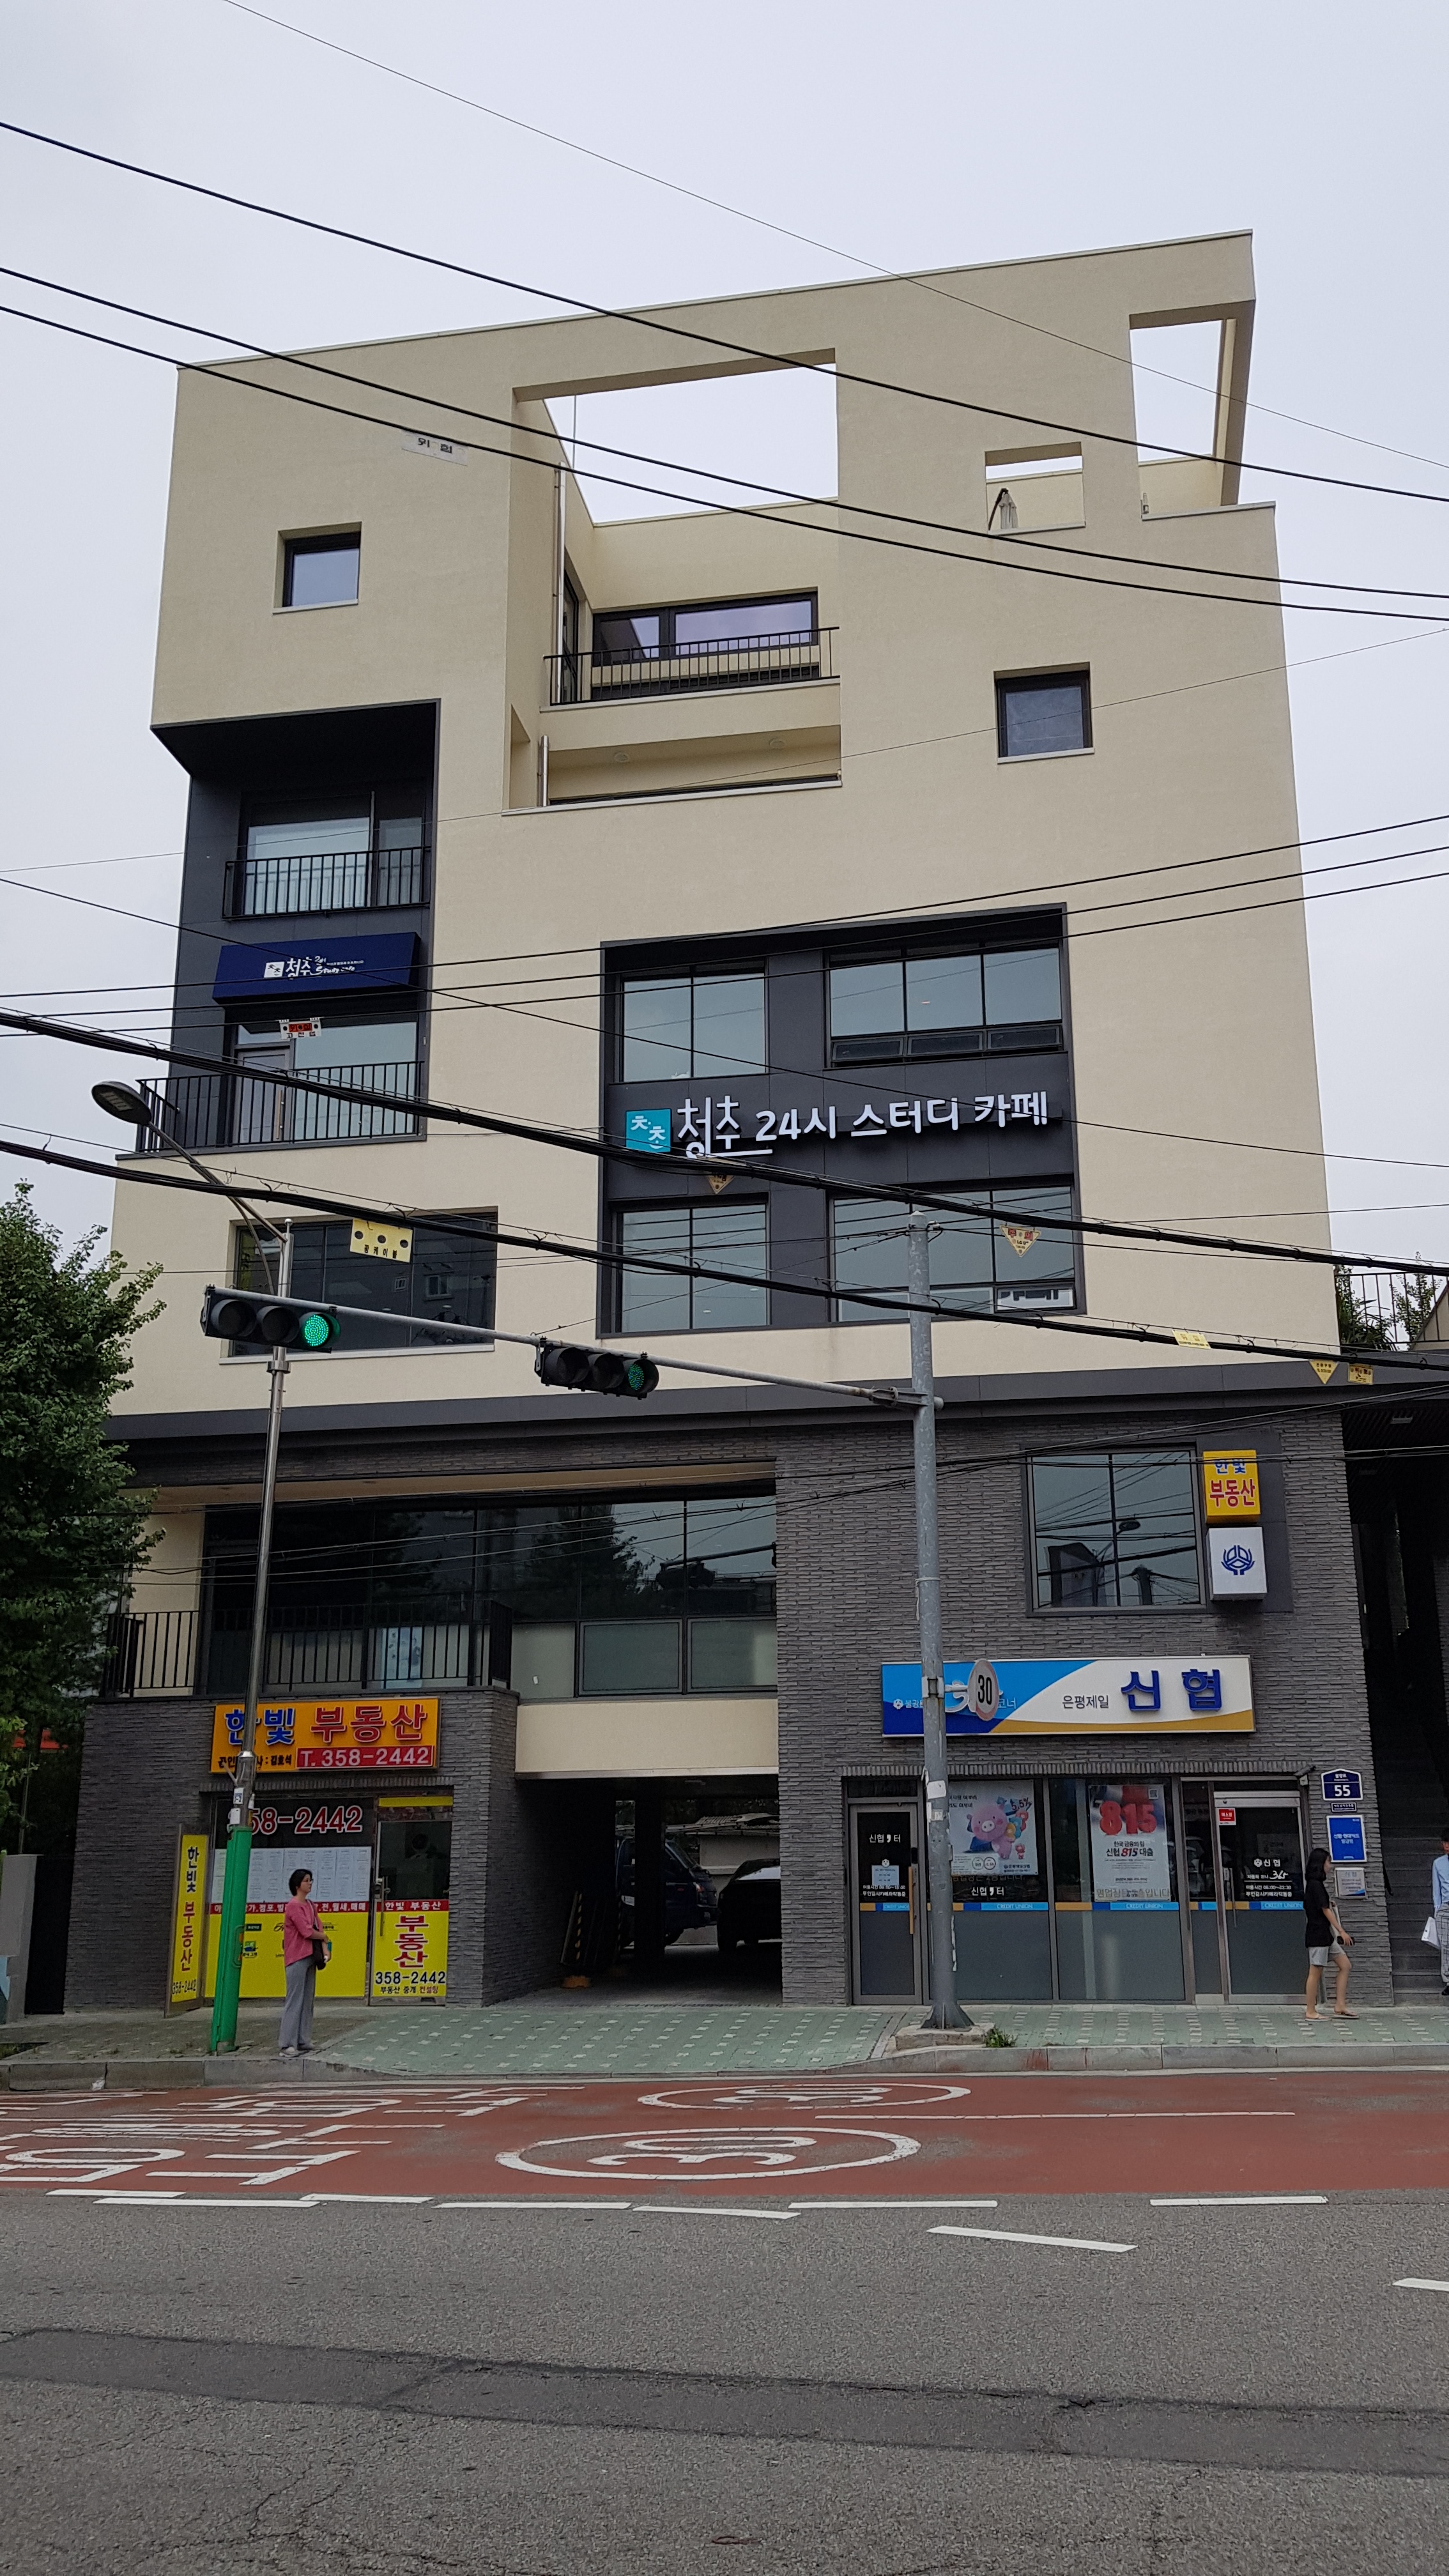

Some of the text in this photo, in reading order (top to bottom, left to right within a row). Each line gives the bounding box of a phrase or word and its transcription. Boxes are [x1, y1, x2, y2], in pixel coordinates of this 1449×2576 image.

[756, 1105, 836, 1142] 24시
[850, 1097, 958, 1137] 스터디
[974, 1091, 1048, 1128] 카페
[1213, 1459, 1246, 1475] 한빛
[1209, 1478, 1256, 1508] 부동산
[977, 1674, 993, 1706] 30
[1061, 1668, 1223, 1712] 은평제일 신협
[310, 1704, 428, 1744] 부동산
[1334, 1784, 1351, 1797] 55
[251, 1805, 363, 1836] 58-2442
[1099, 1800, 1157, 1836] 815
[1106, 1848, 1120, 1857] 신협
[1121, 1848, 1138, 1857] 815
[180, 1846, 199, 1973] 한빛 부동산
[385, 1901, 441, 1911] 한빛 부동산
[394, 1915, 429, 1969] 부동산
[374, 1970, 447, 1985] 358-2442
[379, 1986, 439, 1995] 부동산 중개 컨설팅
